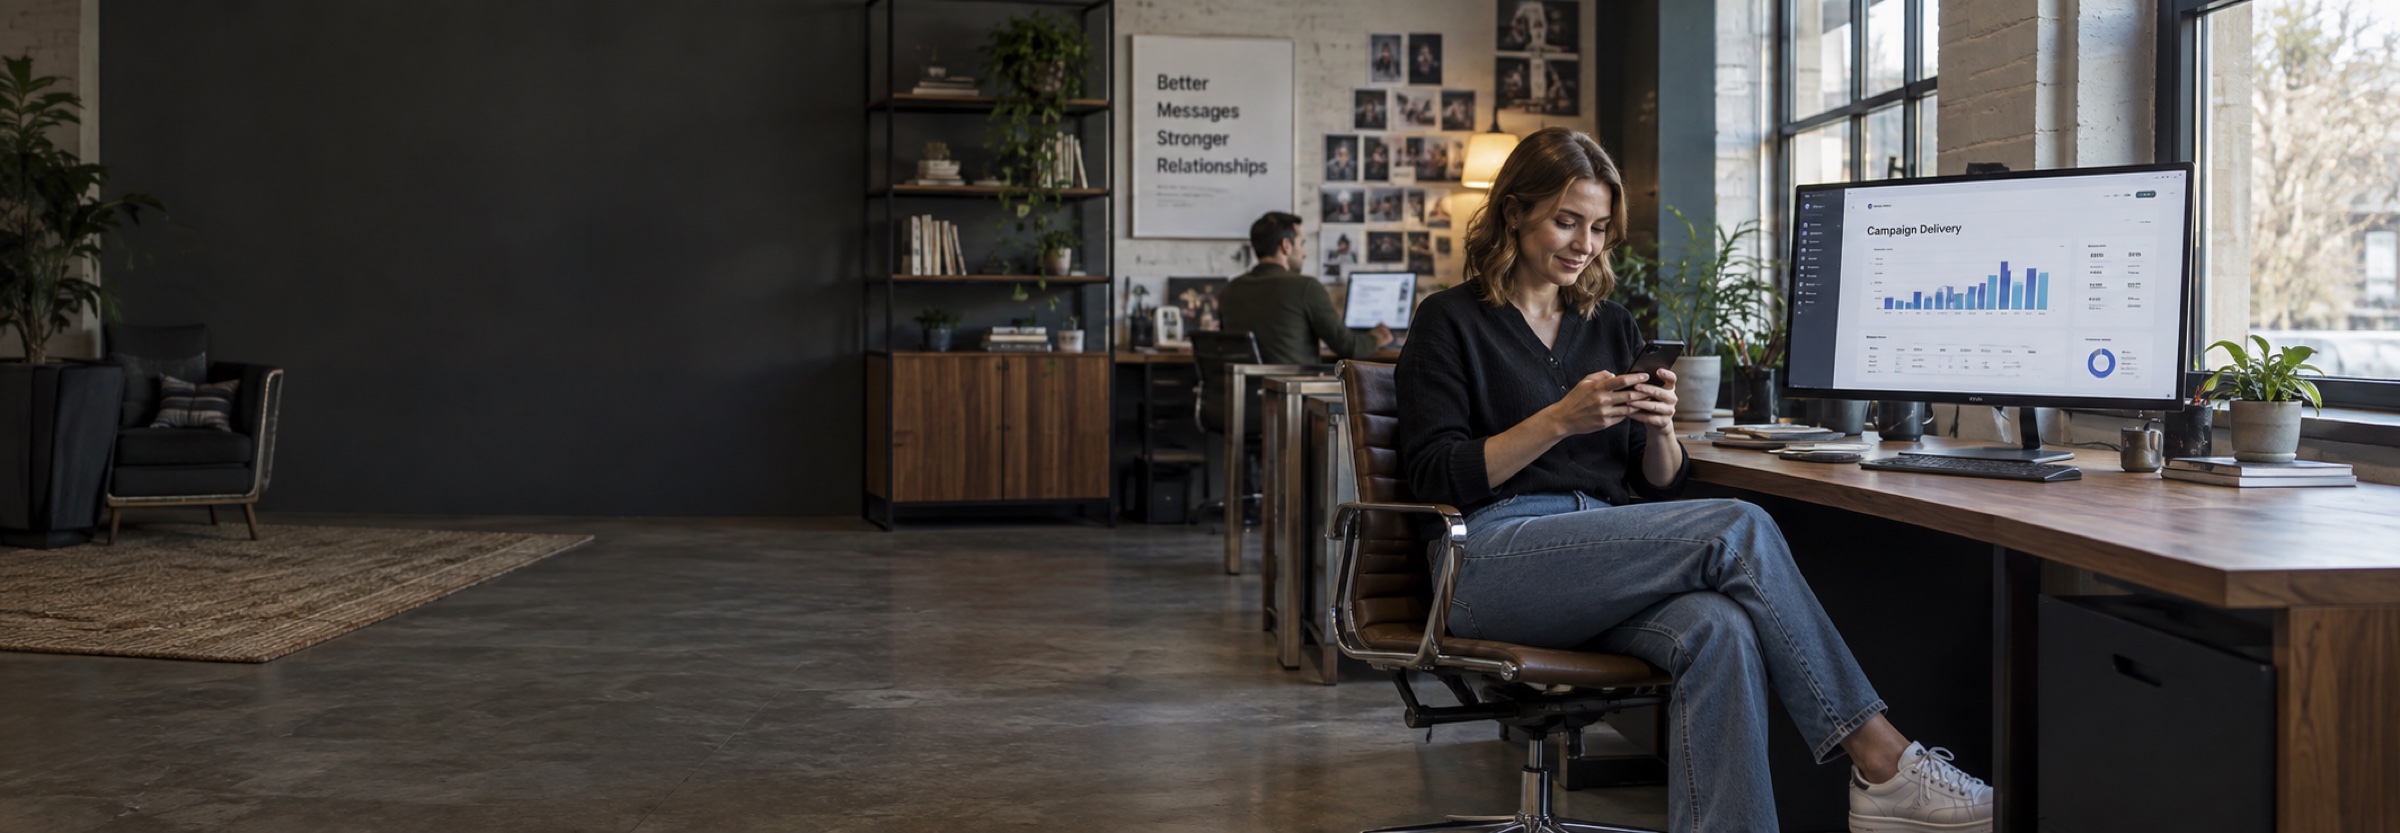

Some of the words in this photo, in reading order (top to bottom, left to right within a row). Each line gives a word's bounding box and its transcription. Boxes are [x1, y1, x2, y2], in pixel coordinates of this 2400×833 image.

[1157, 74, 1209, 91] Better
[1157, 102, 1240, 123] Messages
[1157, 130, 1230, 151] Stronger
[1157, 157, 1268, 178] Relationships
[1867, 225, 1917, 237] Campaign
[1920, 224, 1962, 235] Delivery
